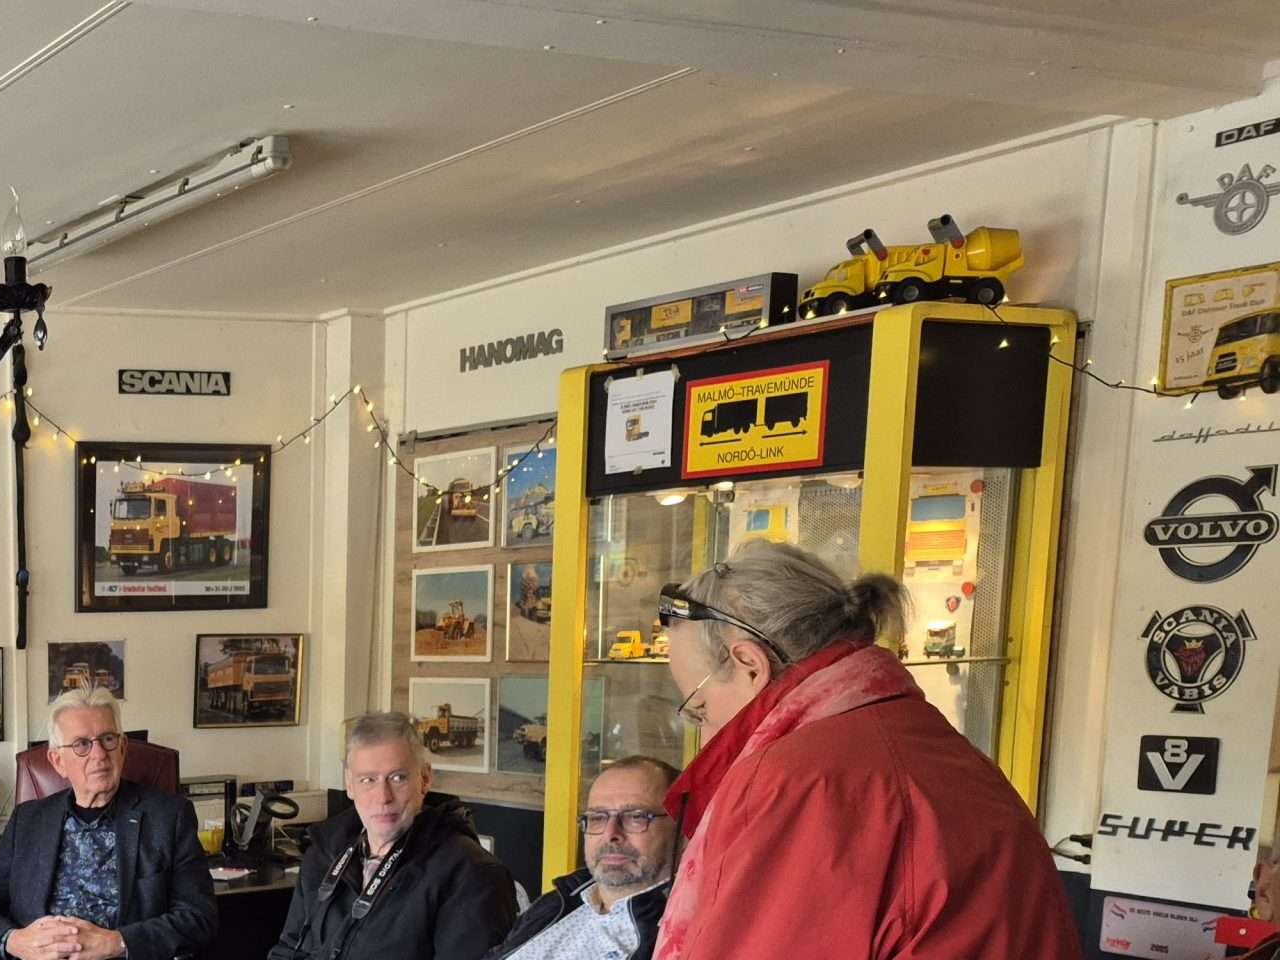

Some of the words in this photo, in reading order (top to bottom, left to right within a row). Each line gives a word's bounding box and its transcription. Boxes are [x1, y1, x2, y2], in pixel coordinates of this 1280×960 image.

[1220, 119, 1277, 146] DAF
[1216, 163, 1277, 191] DAF
[459, 328, 564, 373] HANOMAG
[121, 370, 228, 394] SCANIA
[1151, 518, 1269, 544] VOLVO
[1151, 607, 1239, 646] SCANIA
[1153, 671, 1228, 701] VABIS
[1097, 813, 1257, 851] SUPER
[366, 877, 381, 896] EOS
[378, 848, 404, 877] DIGITAL
